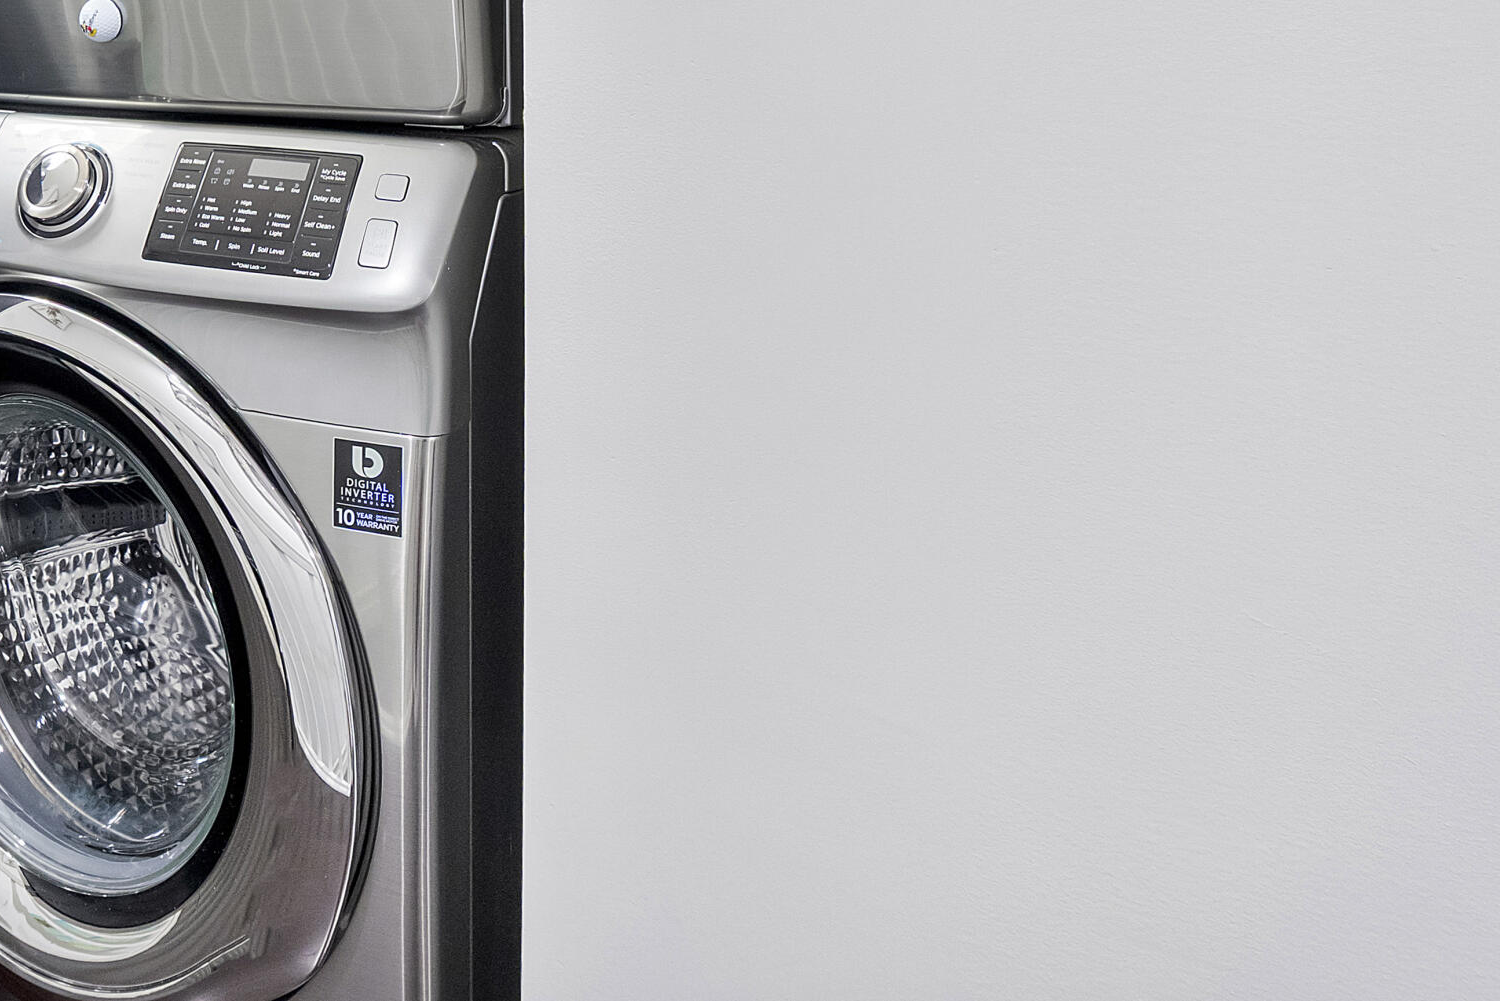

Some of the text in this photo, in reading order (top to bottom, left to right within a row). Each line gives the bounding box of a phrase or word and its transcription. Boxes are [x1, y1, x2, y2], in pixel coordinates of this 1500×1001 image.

[332, 169, 347, 177] Cycle
[312, 194, 342, 204] Delay End
[176, 207, 188, 215] Only
[274, 212, 291, 220] Heavy
[271, 221, 291, 229] Normal
[160, 232, 175, 240] Steam
[269, 230, 282, 238] Light
[192, 238, 208, 246] Temp.
[228, 242, 241, 250] Spin
[257, 246, 285, 256] Soil Level
[301, 250, 321, 258] Sound
[346, 478, 389, 493] DIGITAL
[340, 486, 395, 503] INVERTER
[340, 496, 395, 509] TECHNOLOGY
[335, 507, 374, 526] 10 YEAR
[356, 519, 400, 533] WARRANTY
